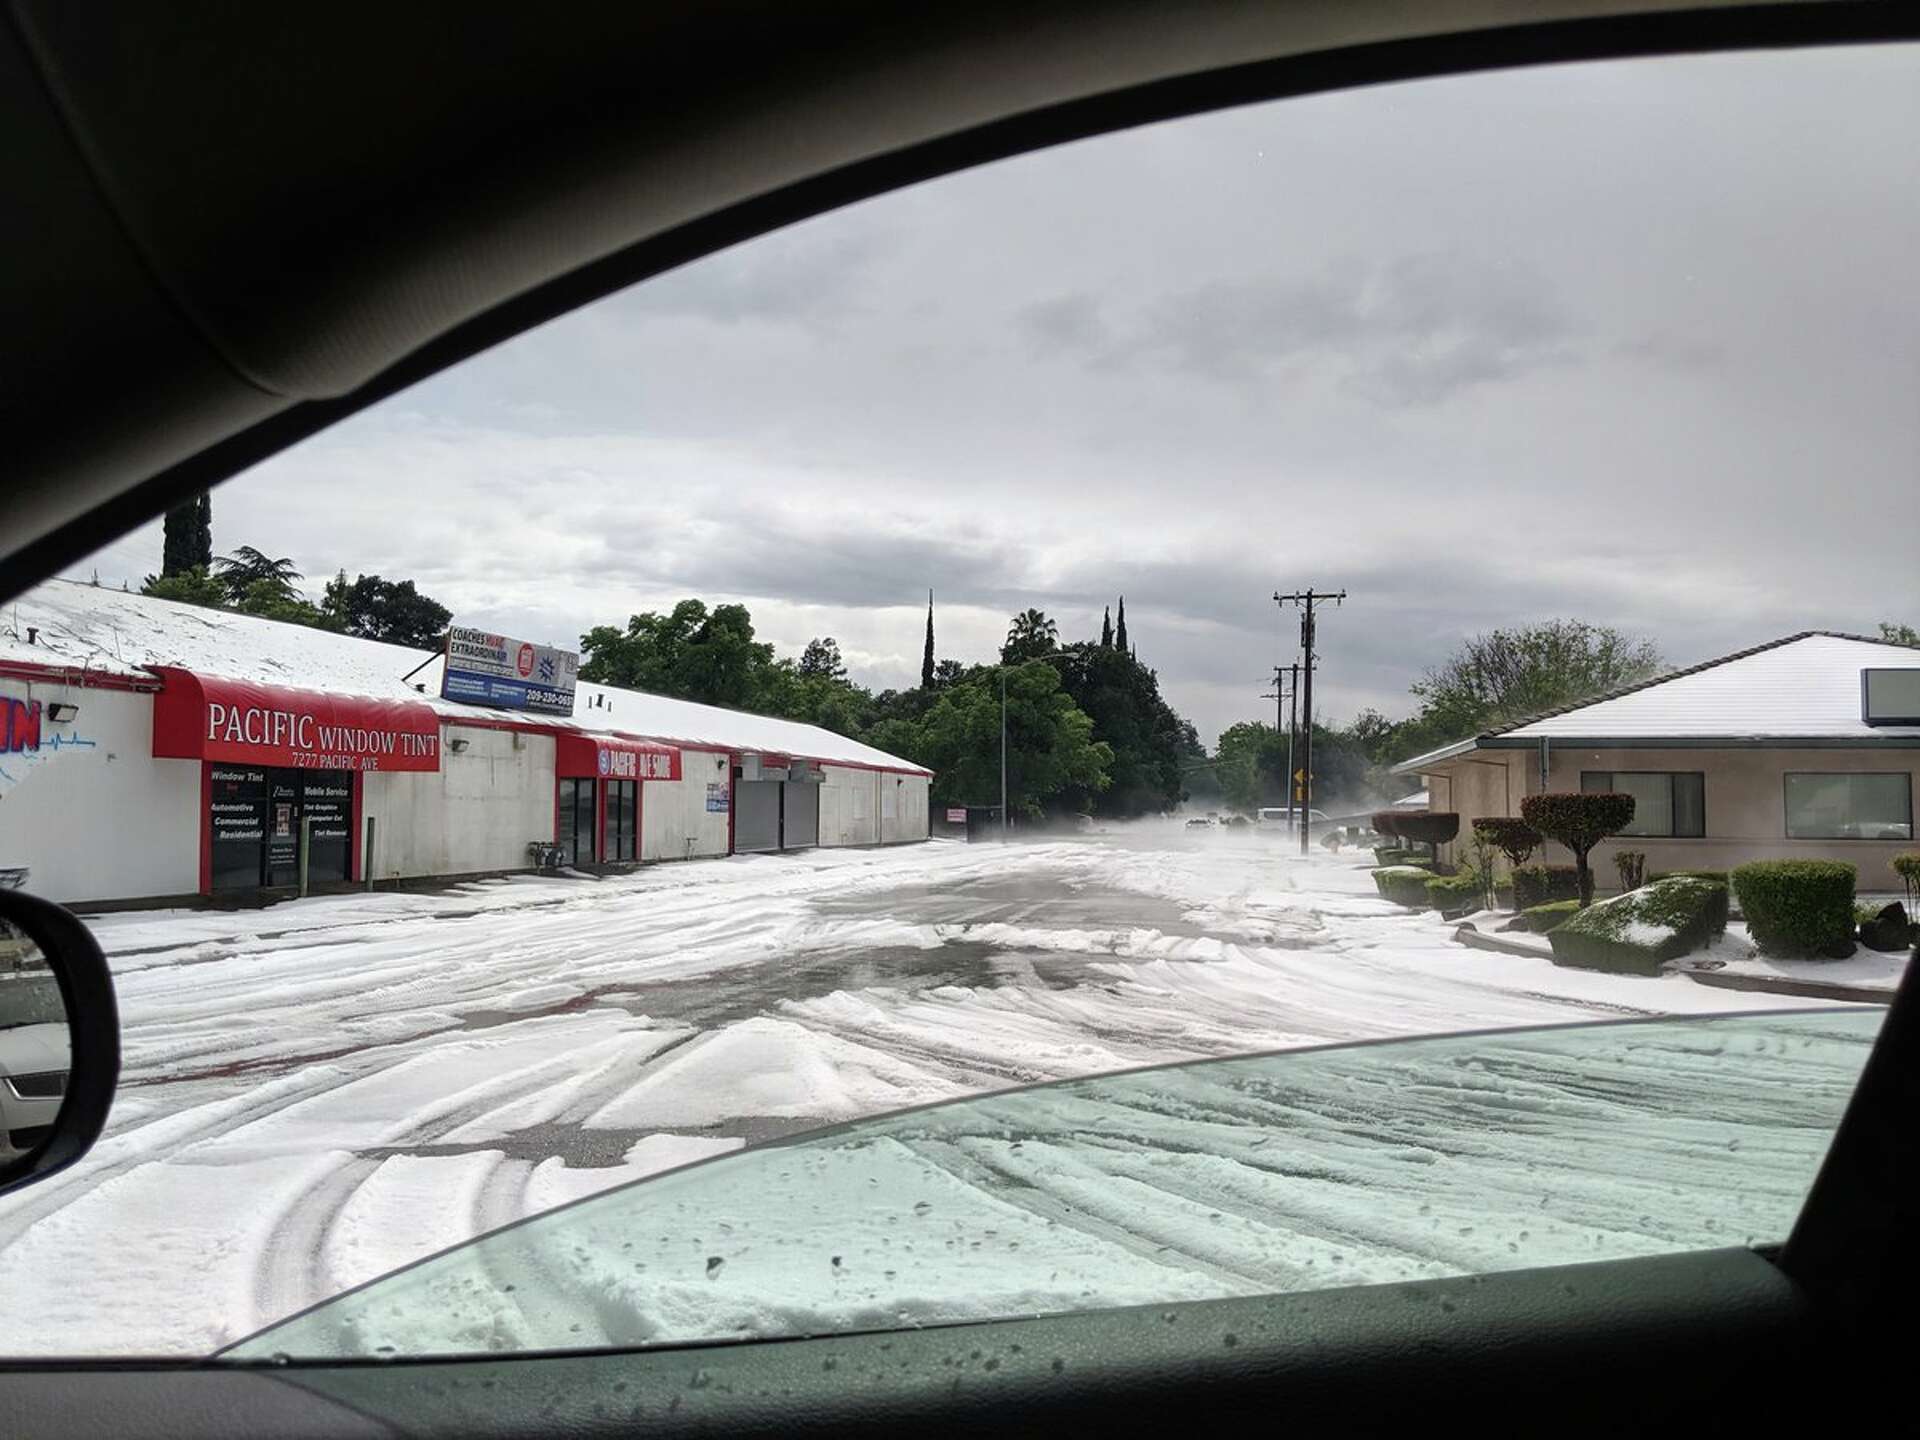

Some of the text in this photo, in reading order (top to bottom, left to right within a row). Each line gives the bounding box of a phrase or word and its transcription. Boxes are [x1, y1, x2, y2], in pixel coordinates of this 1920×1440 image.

[207, 703, 438, 756] PACIFIC WINDOW TINT
[292, 751, 379, 770] 7277 PACIFIC AVE
[211, 770, 264, 782] Window Tint
[304, 787, 325, 797] Mobile
[326, 787, 349, 797] Service
[211, 803, 254, 812] Automotive
[214, 816, 259, 826] Commercial
[219, 829, 264, 839] Residential
